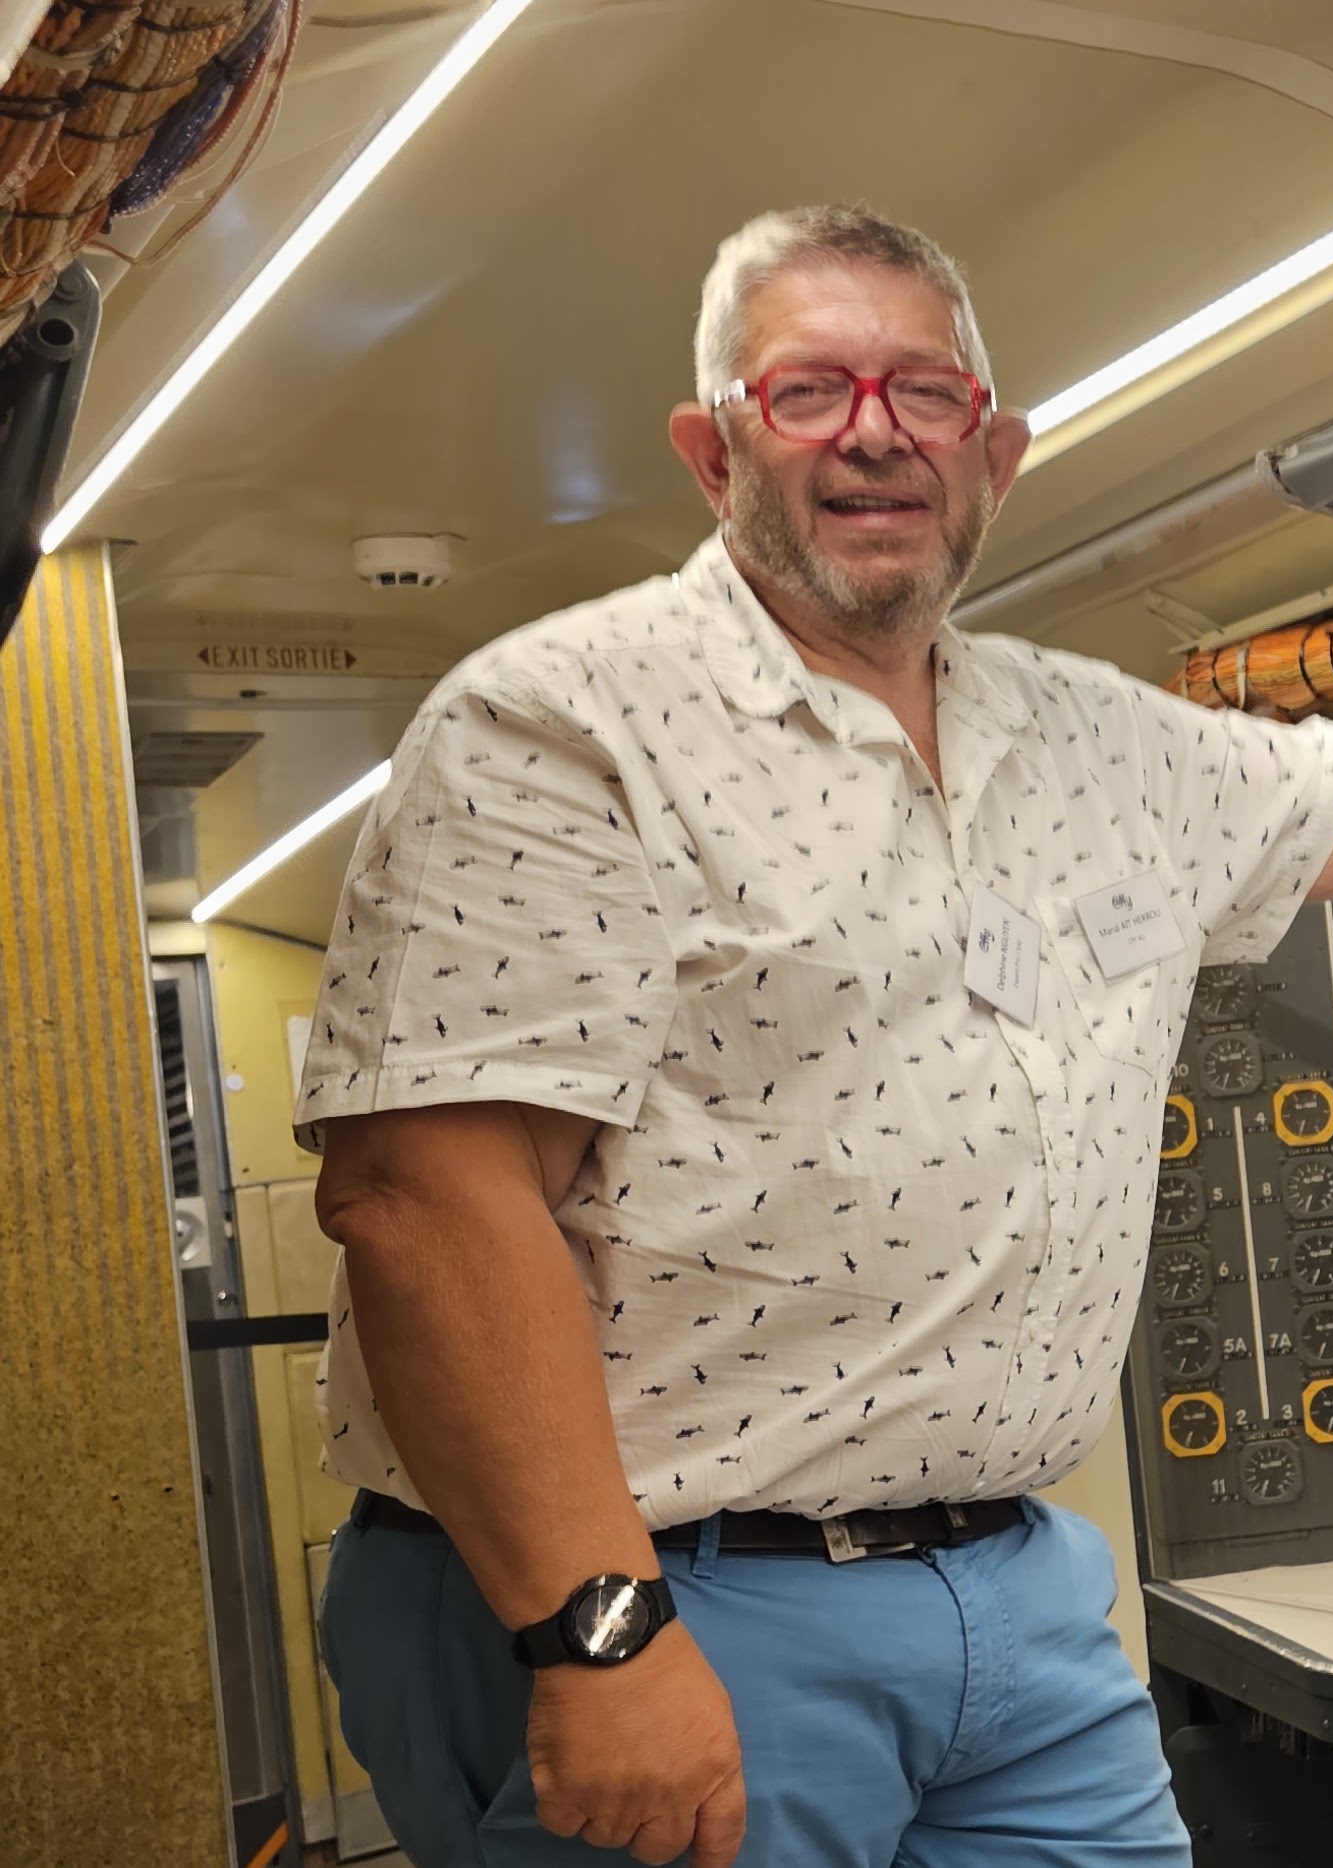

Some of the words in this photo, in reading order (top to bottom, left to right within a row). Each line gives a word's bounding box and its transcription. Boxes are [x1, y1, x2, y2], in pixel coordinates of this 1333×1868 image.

[213, 647, 260, 668] EXIT
[266, 649, 341, 670] SORTIE
[1173, 1063, 1189, 1078] 10
[1254, 1112, 1267, 1125] 4
[1212, 1187, 1223, 1201] 5
[1262, 1182, 1272, 1196] 8
[1219, 1261, 1229, 1277] 6
[1268, 1257, 1279, 1272] 7
[1224, 1338, 1247, 1353] 5A
[1269, 1333, 1292, 1348] 7A
[1235, 1409, 1248, 1425] 2
[1281, 1404, 1293, 1419] 3
[1212, 1479, 1226, 1494] 11
